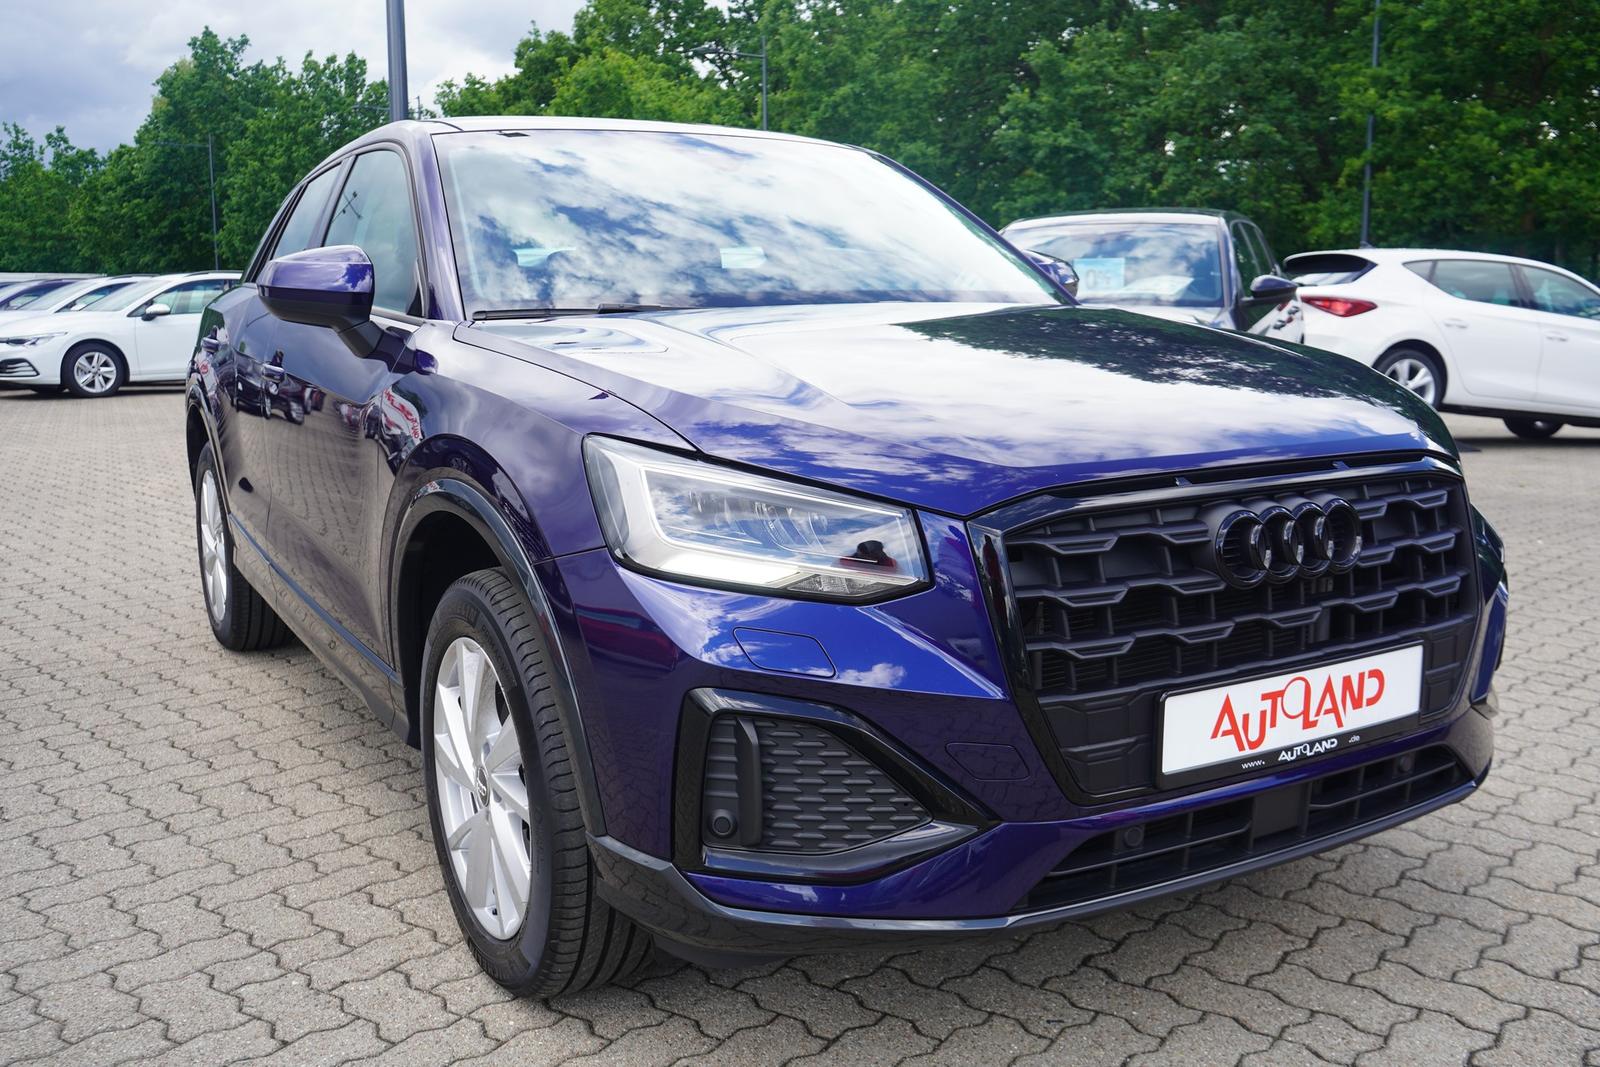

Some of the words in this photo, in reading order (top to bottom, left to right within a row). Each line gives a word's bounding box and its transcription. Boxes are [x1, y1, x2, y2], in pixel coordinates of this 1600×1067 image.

[1210, 668, 1386, 752] AUTOLAND
[1241, 759, 1266, 769] www.
[1278, 738, 1338, 762] AUTOLAND
